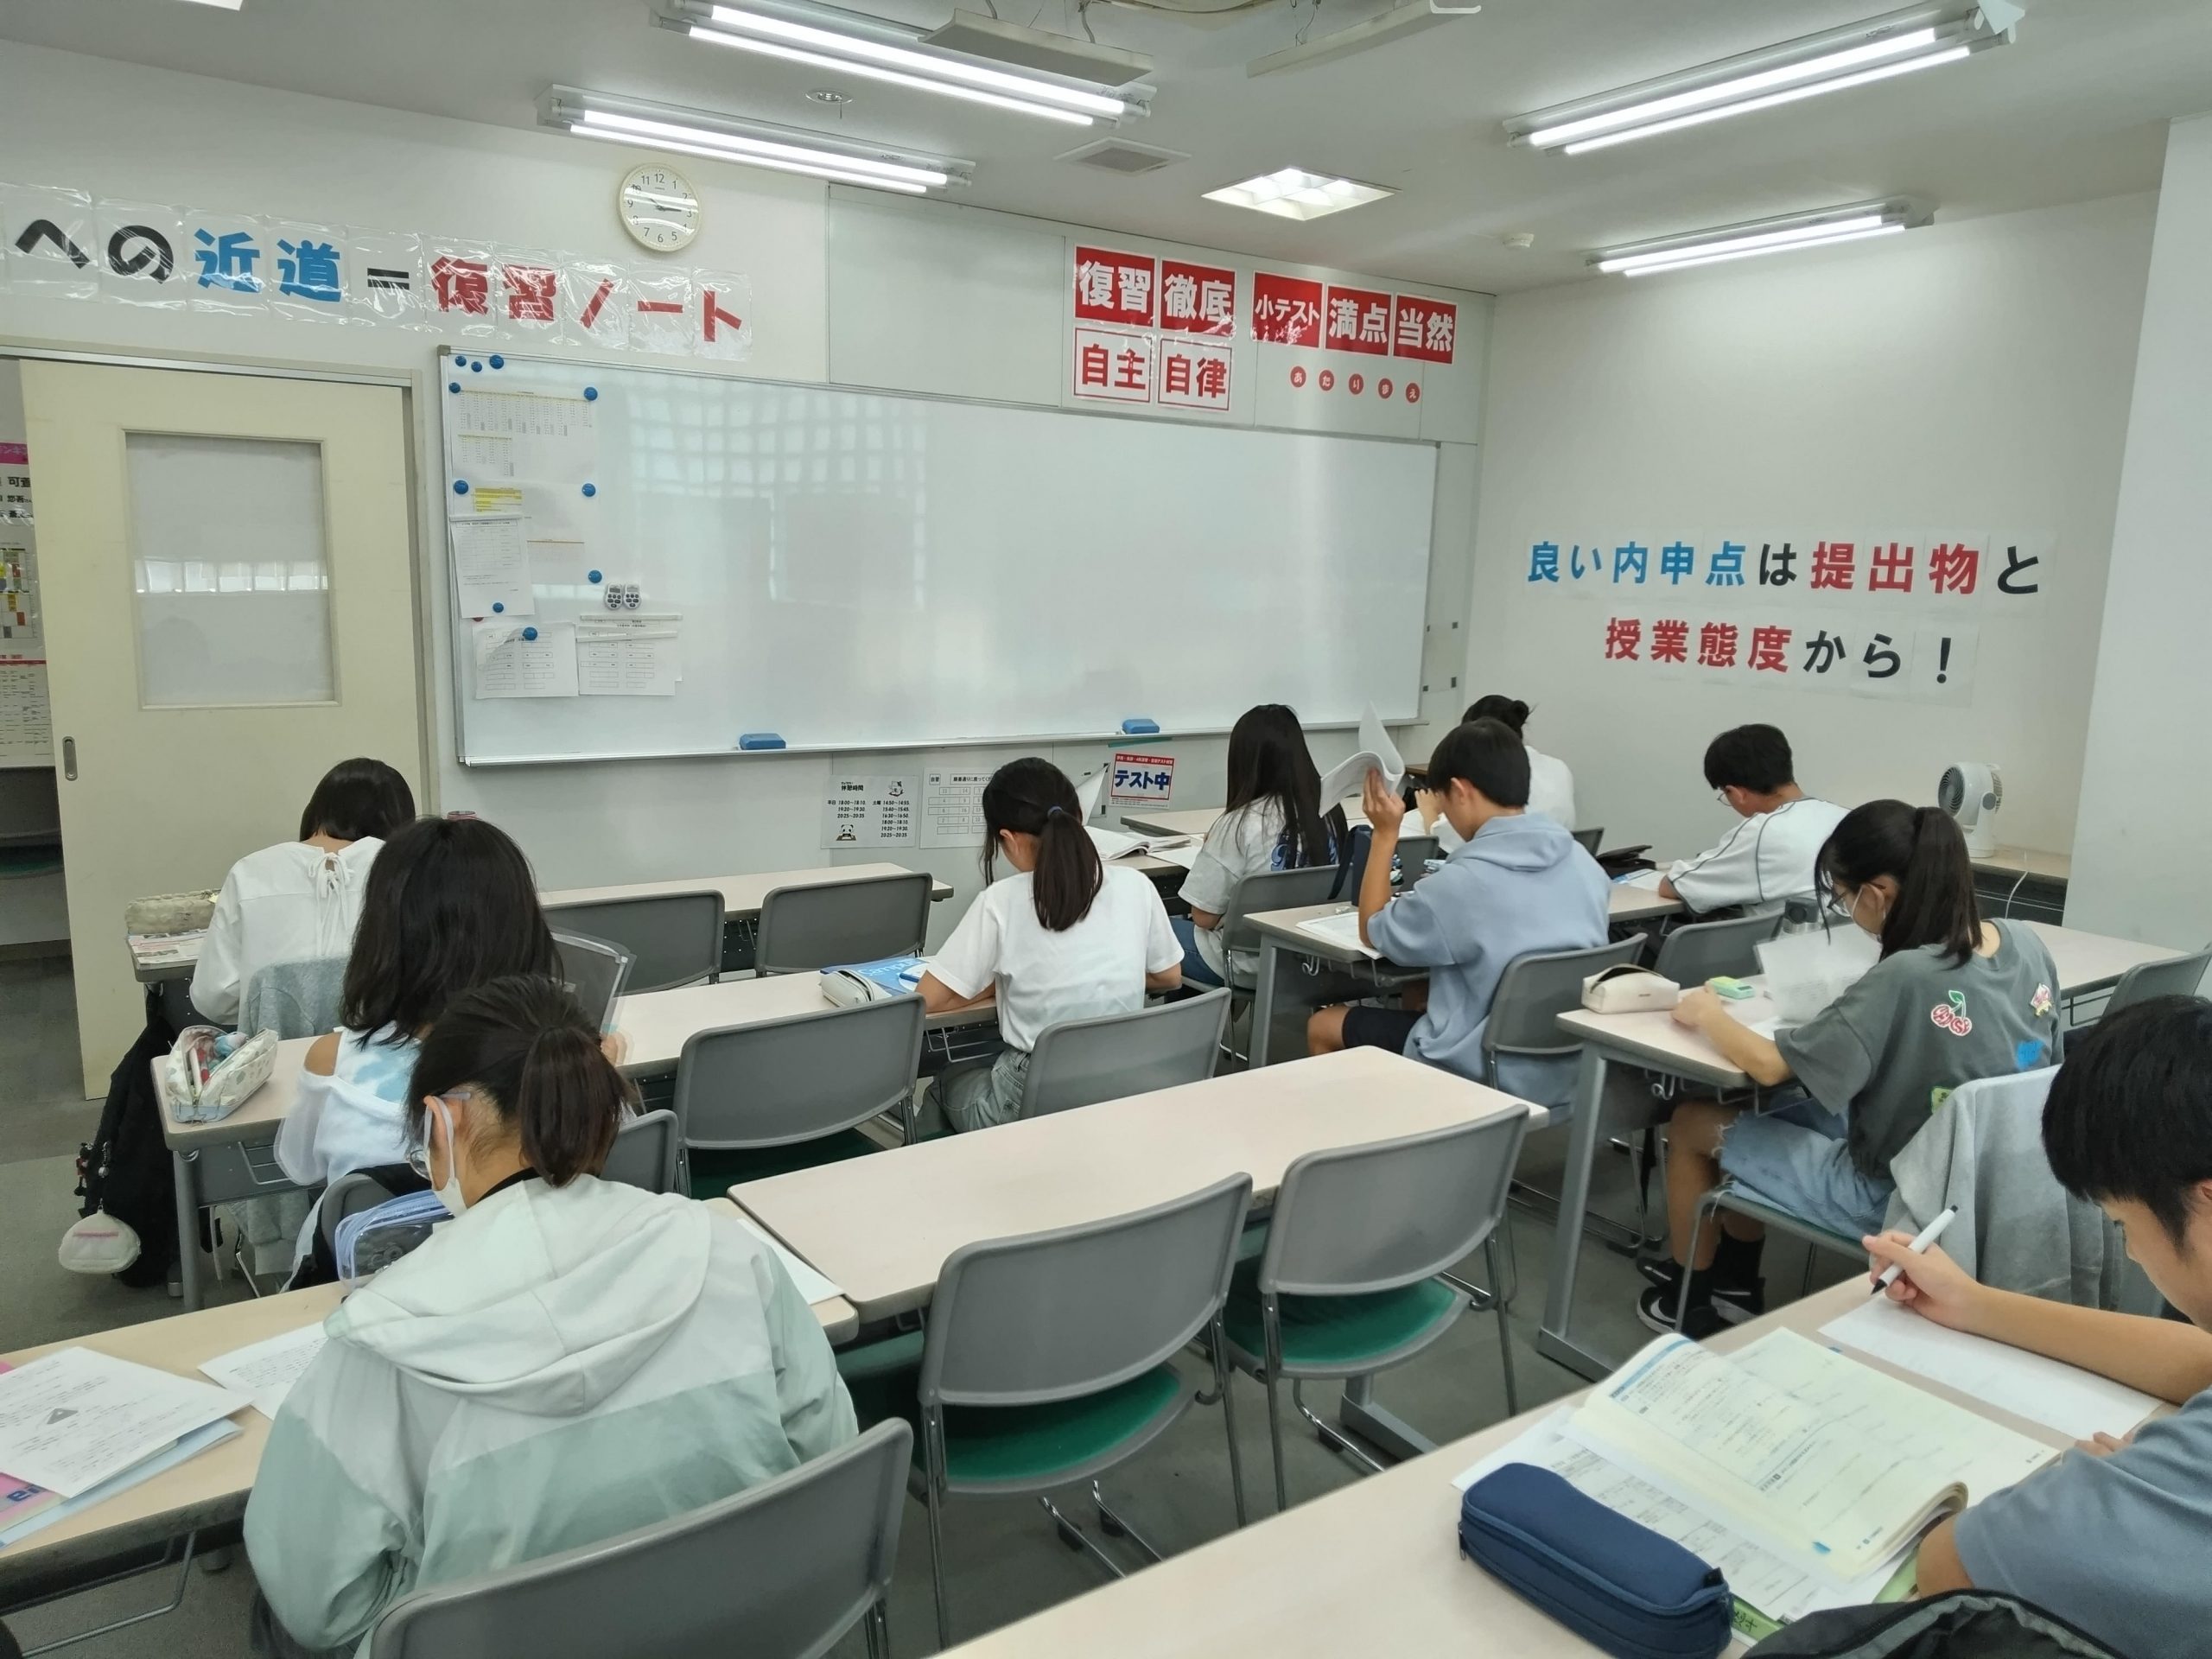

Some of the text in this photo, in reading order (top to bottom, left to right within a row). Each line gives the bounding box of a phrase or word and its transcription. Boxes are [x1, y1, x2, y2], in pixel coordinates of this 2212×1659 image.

[641, 175, 650, 185] 11
[654, 173, 665, 184] 12
[627, 200, 634, 208] 9
[643, 226, 650, 237] 7
[671, 232, 677, 241] 5
[658, 233, 664, 243] 6
[1527, 540, 2040, 595] 良い内申点は提出物と
[1115, 769, 1171, 791] テスト中
